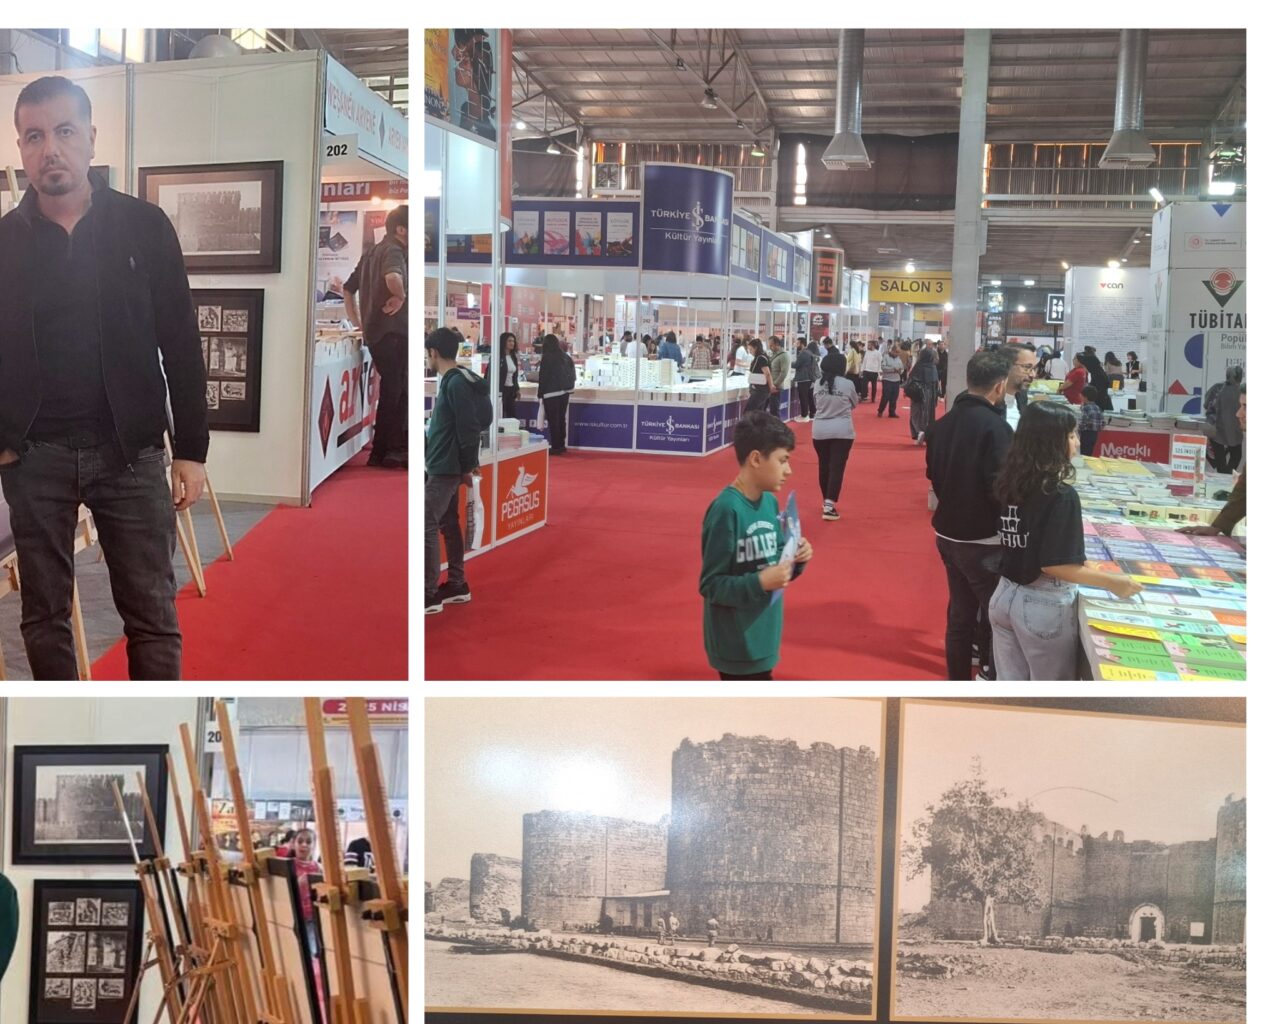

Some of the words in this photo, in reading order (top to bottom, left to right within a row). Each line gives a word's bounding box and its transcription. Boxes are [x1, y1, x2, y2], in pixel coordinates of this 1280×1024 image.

[326, 144, 348, 156] 202
[651, 208, 690, 220] TÜRKİYE
[665, 232, 691, 241] Kültür
[880, 280, 930, 292] SALON
[935, 281, 943, 293] 3
[1189, 310, 1247, 328] TÜBİTA
[641, 420, 666, 428] TÜRKİYE
[1100, 442, 1151, 457] Meraklı
[501, 490, 540, 521] PEGASUS
[208, 731, 222, 743] 20
